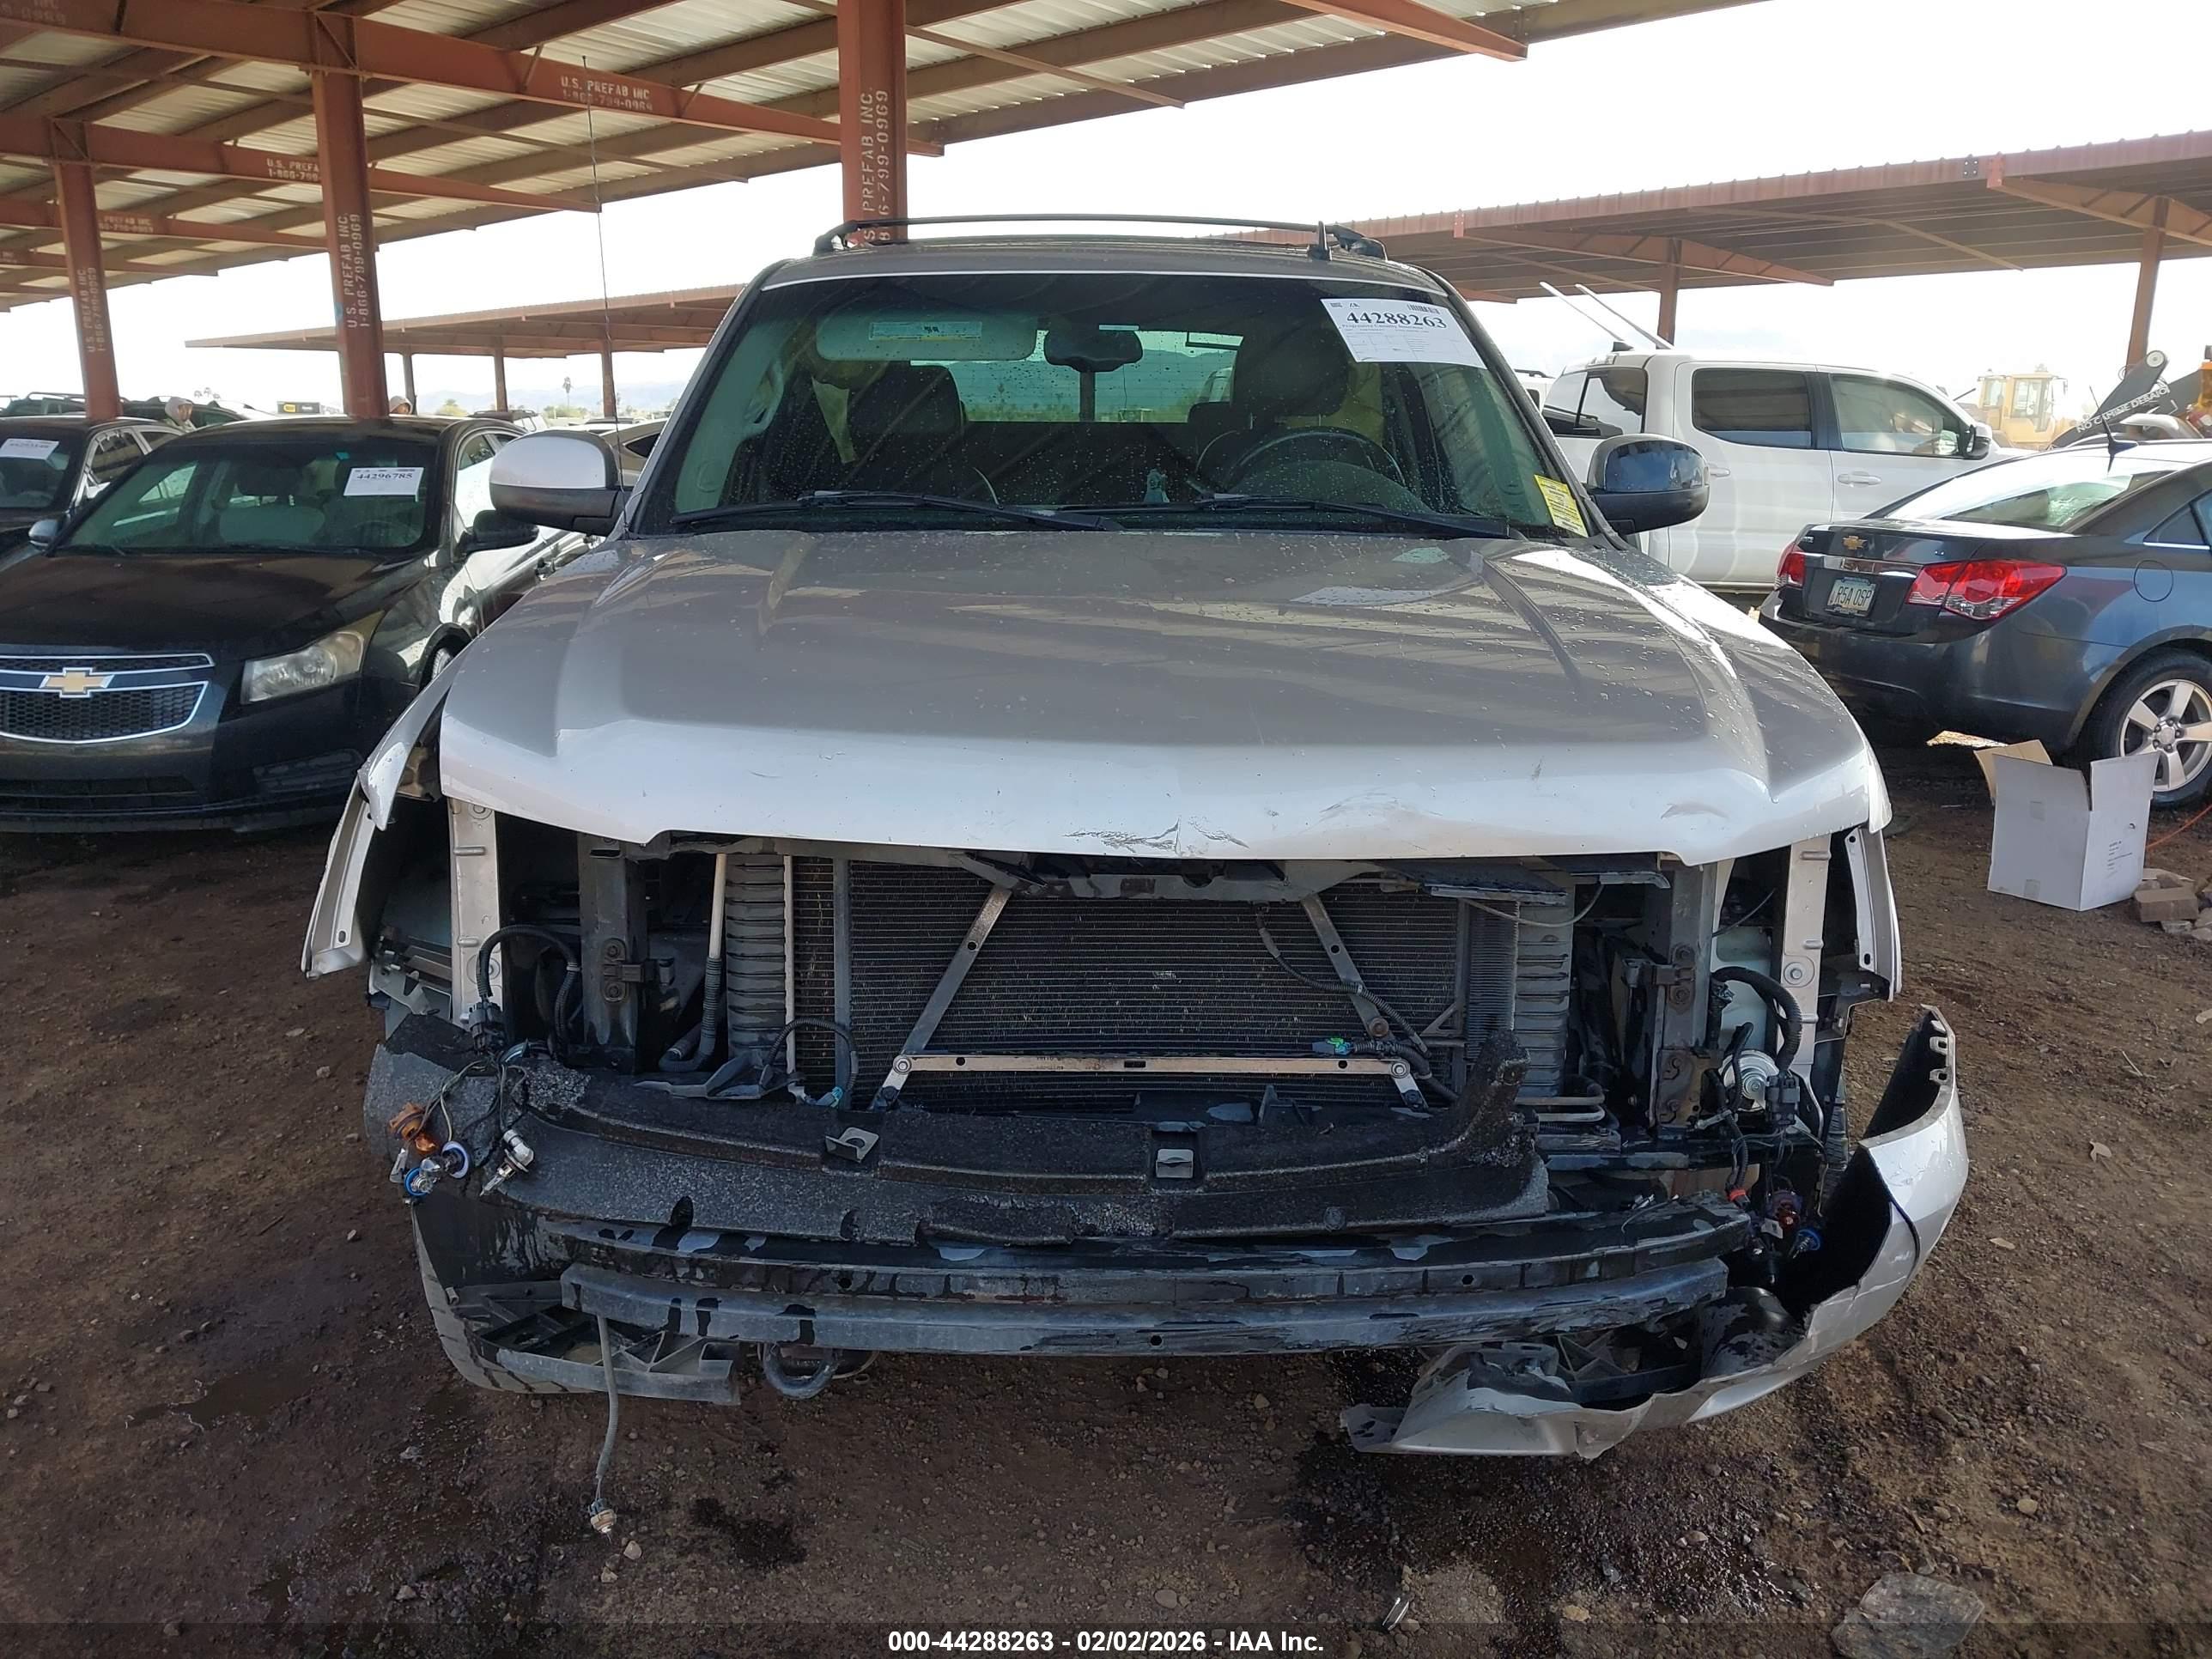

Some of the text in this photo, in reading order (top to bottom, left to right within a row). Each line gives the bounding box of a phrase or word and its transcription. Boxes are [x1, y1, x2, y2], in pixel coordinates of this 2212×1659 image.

[561, 76, 582, 90] U.S.
[587, 81, 629, 97] PREFAB
[289, 161, 319, 172] PREFA
[861, 136, 875, 211] PREFAB
[340, 244, 355, 295] PREFAB
[349, 214, 371, 327] 1-866-799-0969
[346, 303, 358, 328] U.S.
[1347, 312, 1447, 328] 44288263
[2076, 421, 2093, 433] NO
